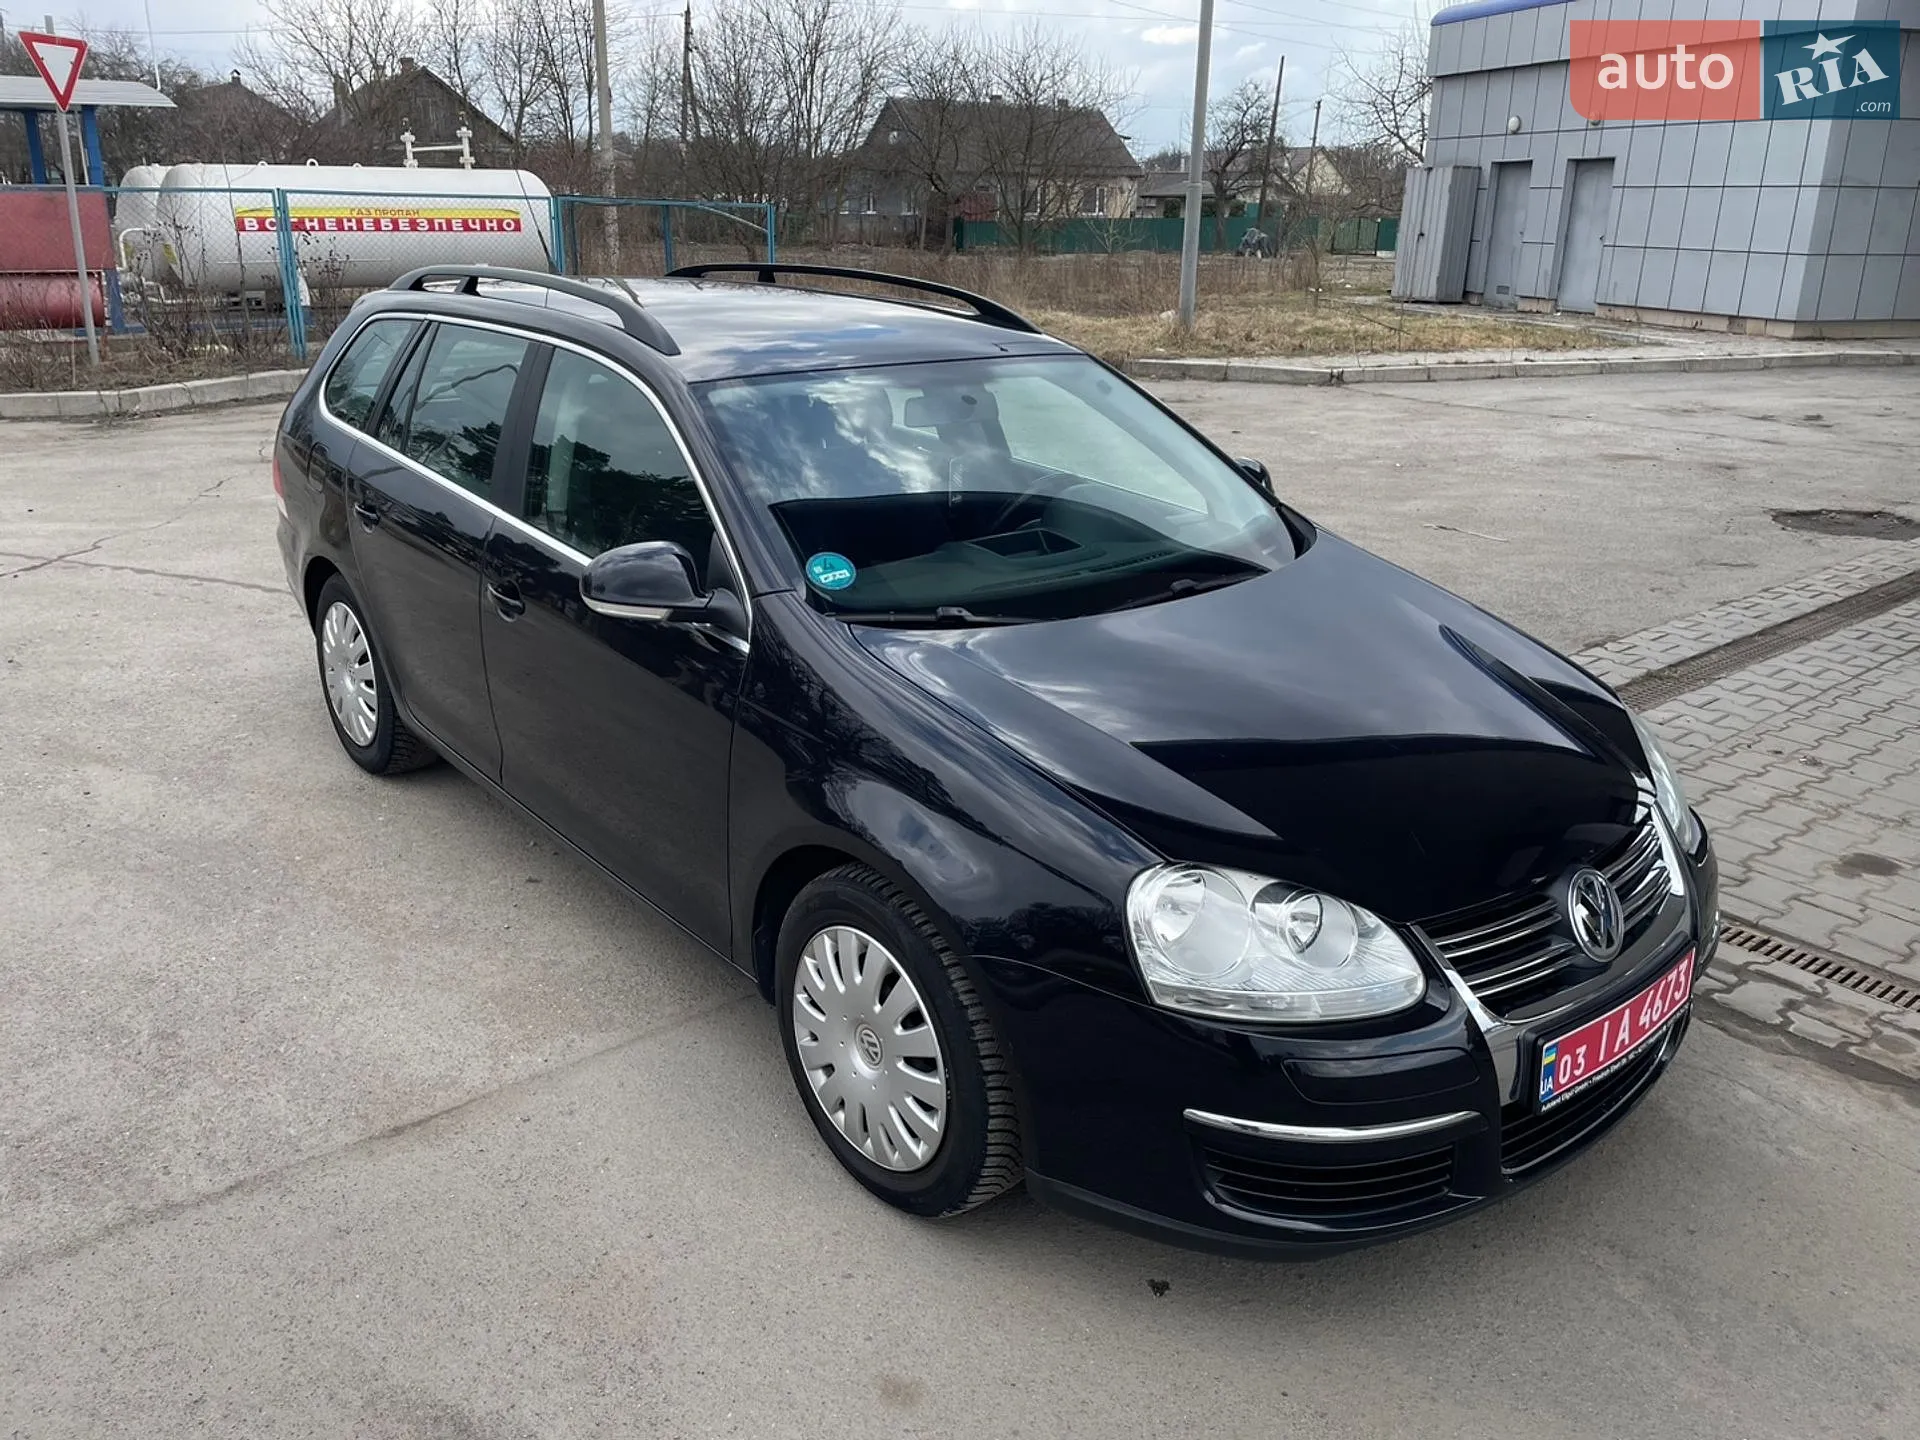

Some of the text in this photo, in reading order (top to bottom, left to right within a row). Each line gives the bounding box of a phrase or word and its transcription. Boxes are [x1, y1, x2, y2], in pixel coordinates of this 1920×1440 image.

[350, 208, 420, 217] ГАЗ ПРОПАН
[1558, 1044, 1587, 1085] 03
[1598, 1008, 1631, 1062] IA
[1638, 959, 1689, 1030] 4673
[1540, 1076, 1554, 1095] UA
